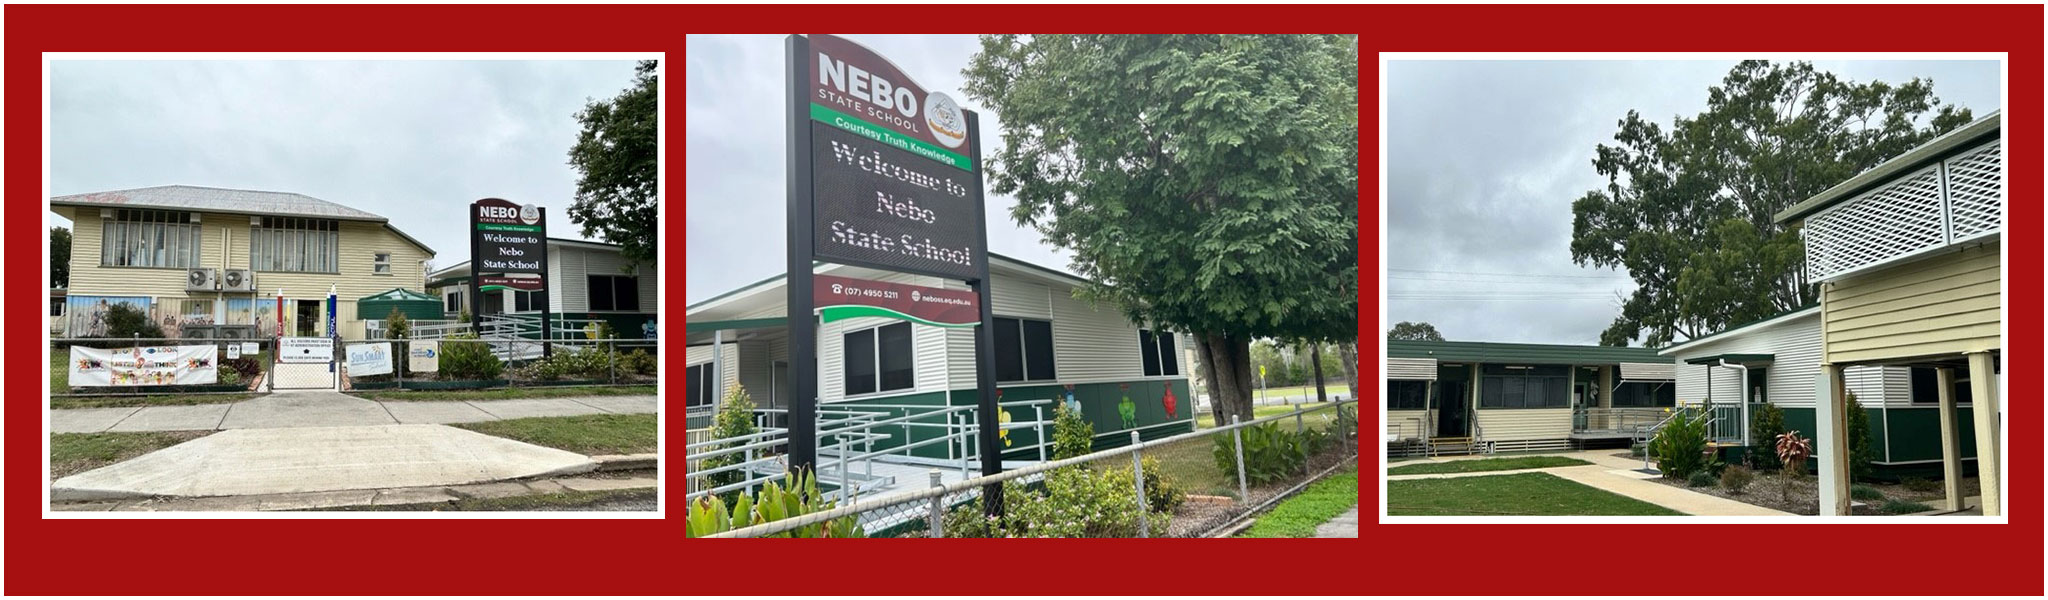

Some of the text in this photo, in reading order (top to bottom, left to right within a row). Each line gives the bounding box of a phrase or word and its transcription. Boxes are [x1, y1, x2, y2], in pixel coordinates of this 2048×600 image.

[818, 52, 918, 118] NEBO
[818, 88, 862, 112] STATE
[867, 106, 919, 133] SCHOOL
[835, 117, 956, 165] Courtesy Truth Knowledge
[831, 140, 966, 198] Welcome to
[480, 206, 518, 218] NEBO
[876, 191, 936, 224] Nebo
[483, 233, 538, 244] Welcome to
[831, 220, 971, 266] State School
[499, 247, 524, 256] Nebo
[483, 259, 539, 269] State School
[844, 285, 899, 299] (07) 4950 5211
[922, 295, 971, 306] neboss.eq.edu.au
